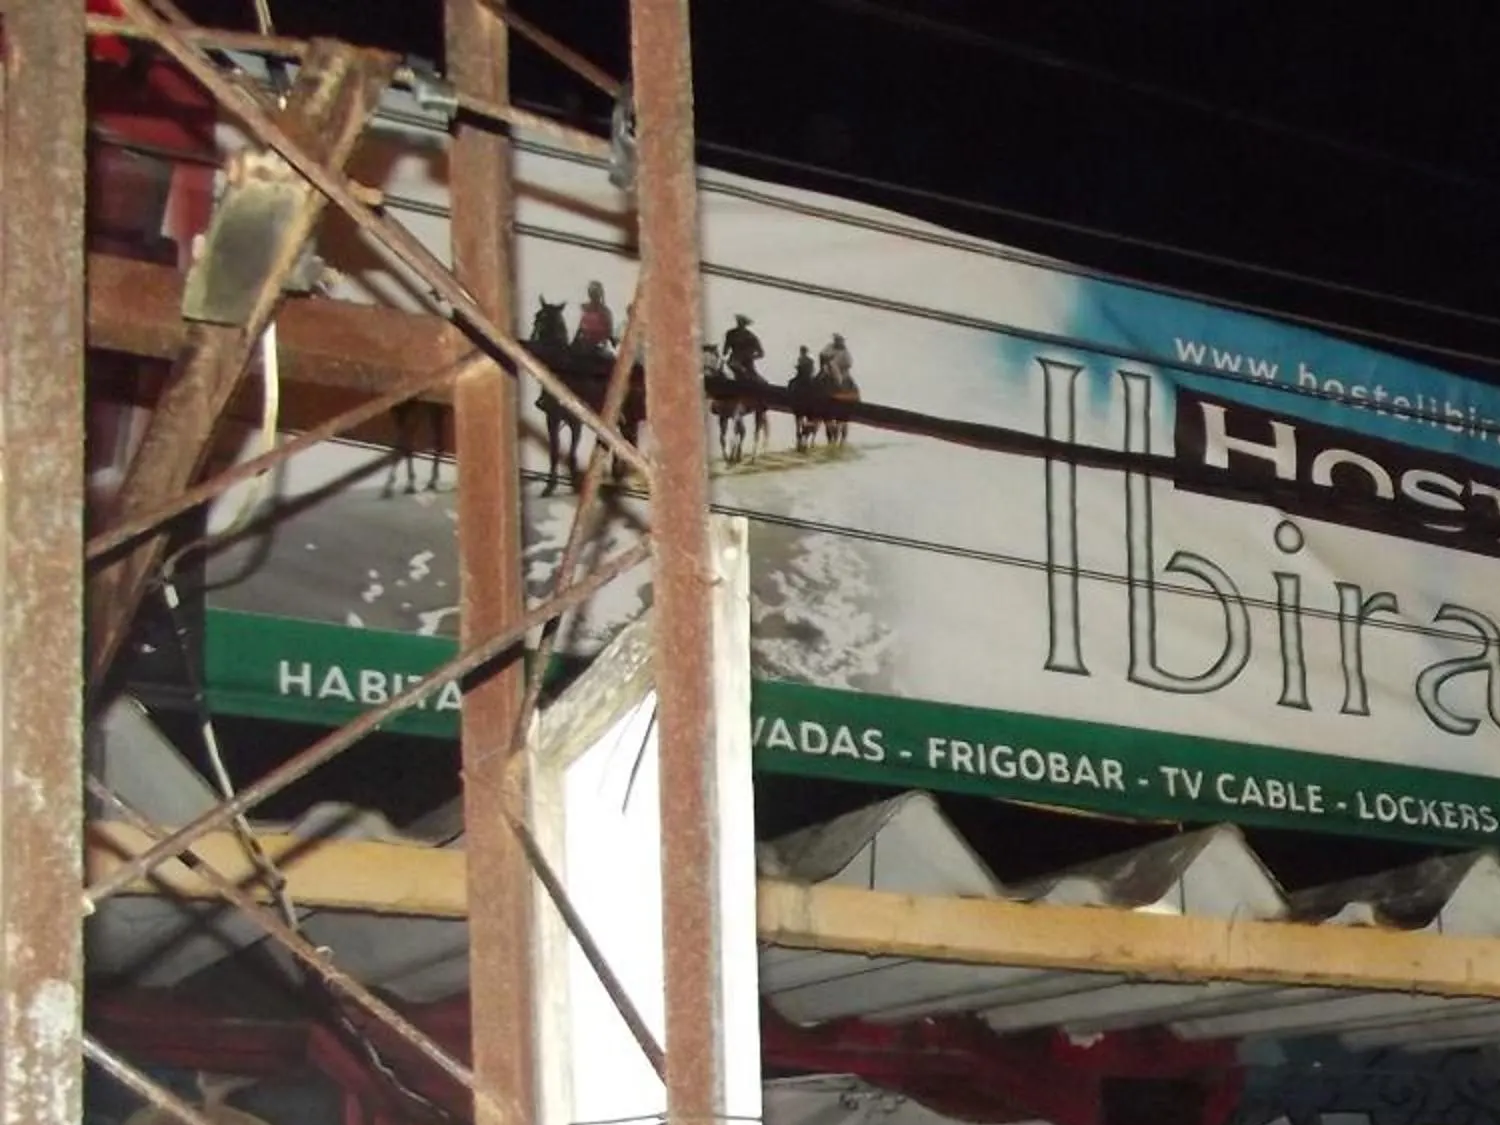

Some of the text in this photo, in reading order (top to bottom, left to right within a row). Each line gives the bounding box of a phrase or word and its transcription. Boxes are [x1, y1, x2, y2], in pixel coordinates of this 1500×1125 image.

[928, 737, 1125, 791] FRIGOBAR
[1160, 765, 1204, 800] TV
[1215, 773, 1325, 814] CABLE
[1356, 790, 1500, 833] LOCKERS
